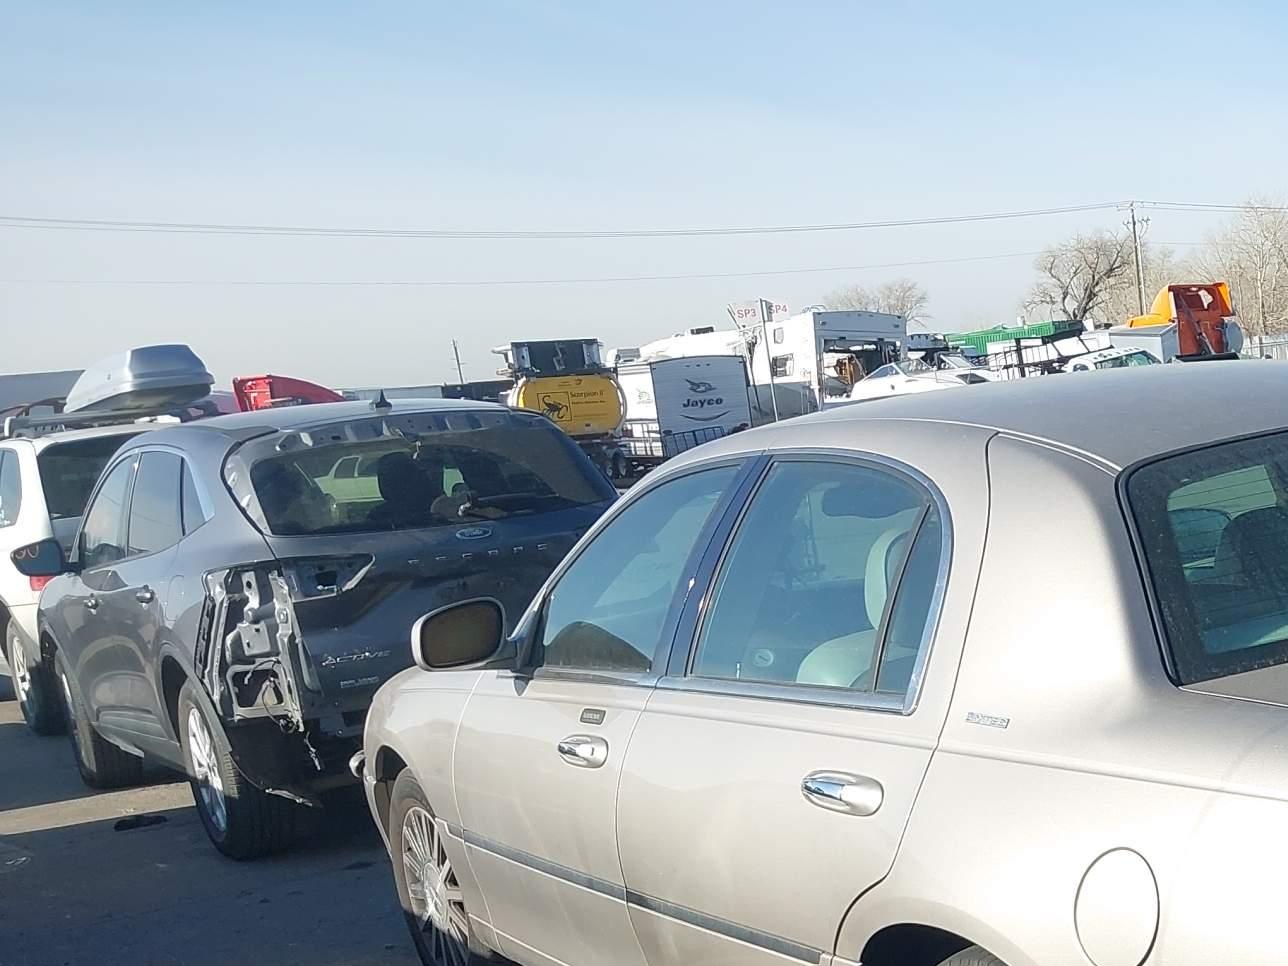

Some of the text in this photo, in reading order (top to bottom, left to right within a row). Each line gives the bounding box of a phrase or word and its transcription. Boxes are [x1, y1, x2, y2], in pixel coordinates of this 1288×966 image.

[736, 308, 757, 319] SP3
[768, 304, 788, 314] SP4
[682, 397, 724, 408] Jayco
